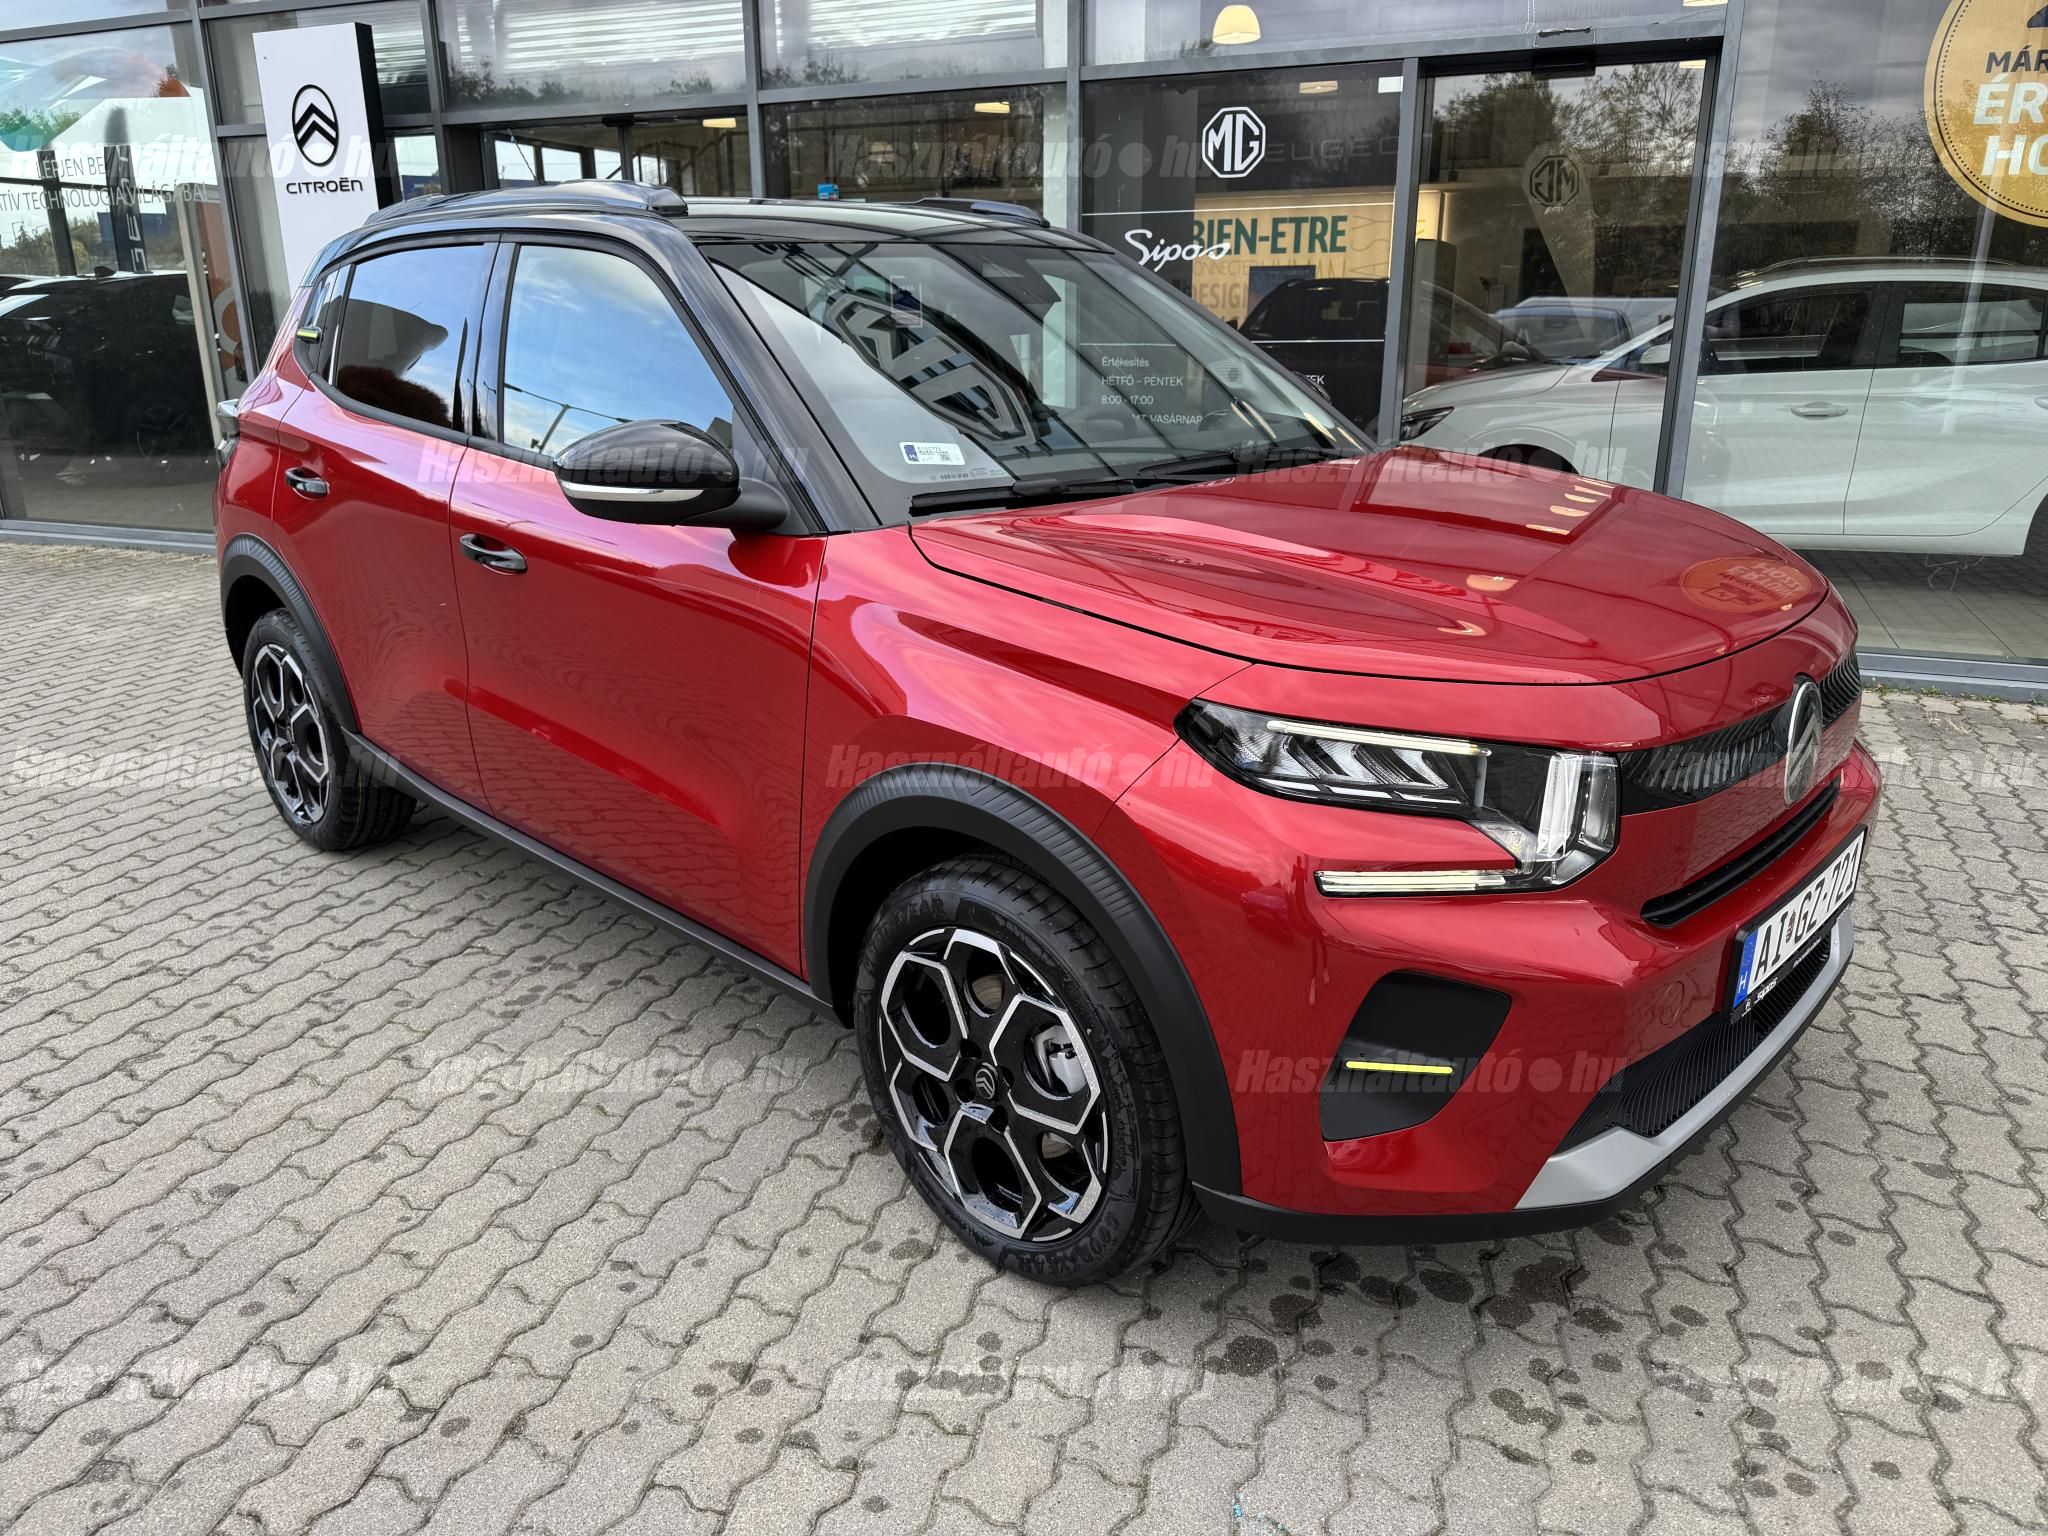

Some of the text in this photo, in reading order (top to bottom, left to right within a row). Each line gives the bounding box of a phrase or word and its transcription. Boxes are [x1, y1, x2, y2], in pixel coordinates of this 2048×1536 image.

[1985, 44, 2048, 74] MÁR
[1973, 72, 2048, 125] ÉR
[1206, 112, 1262, 174] MG
[1264, 136, 1399, 162] EUGEO
[1982, 134, 2048, 177] HO
[36, 155, 84, 179] LÉPJEN
[22, 184, 125, 210] TECHNOLÓGIA
[286, 176, 363, 195] CITROËN
[1193, 215, 1348, 255] BIEN-ETRE
[1124, 229, 1230, 272] Sipos
[1194, 259, 1249, 276] ONNECTE
[1193, 282, 1248, 309] ESIG
[1144, 375, 1183, 387] PÉNTEK
[1101, 395, 1121, 405] 8:00
[1130, 395, 1154, 405] 17:00
